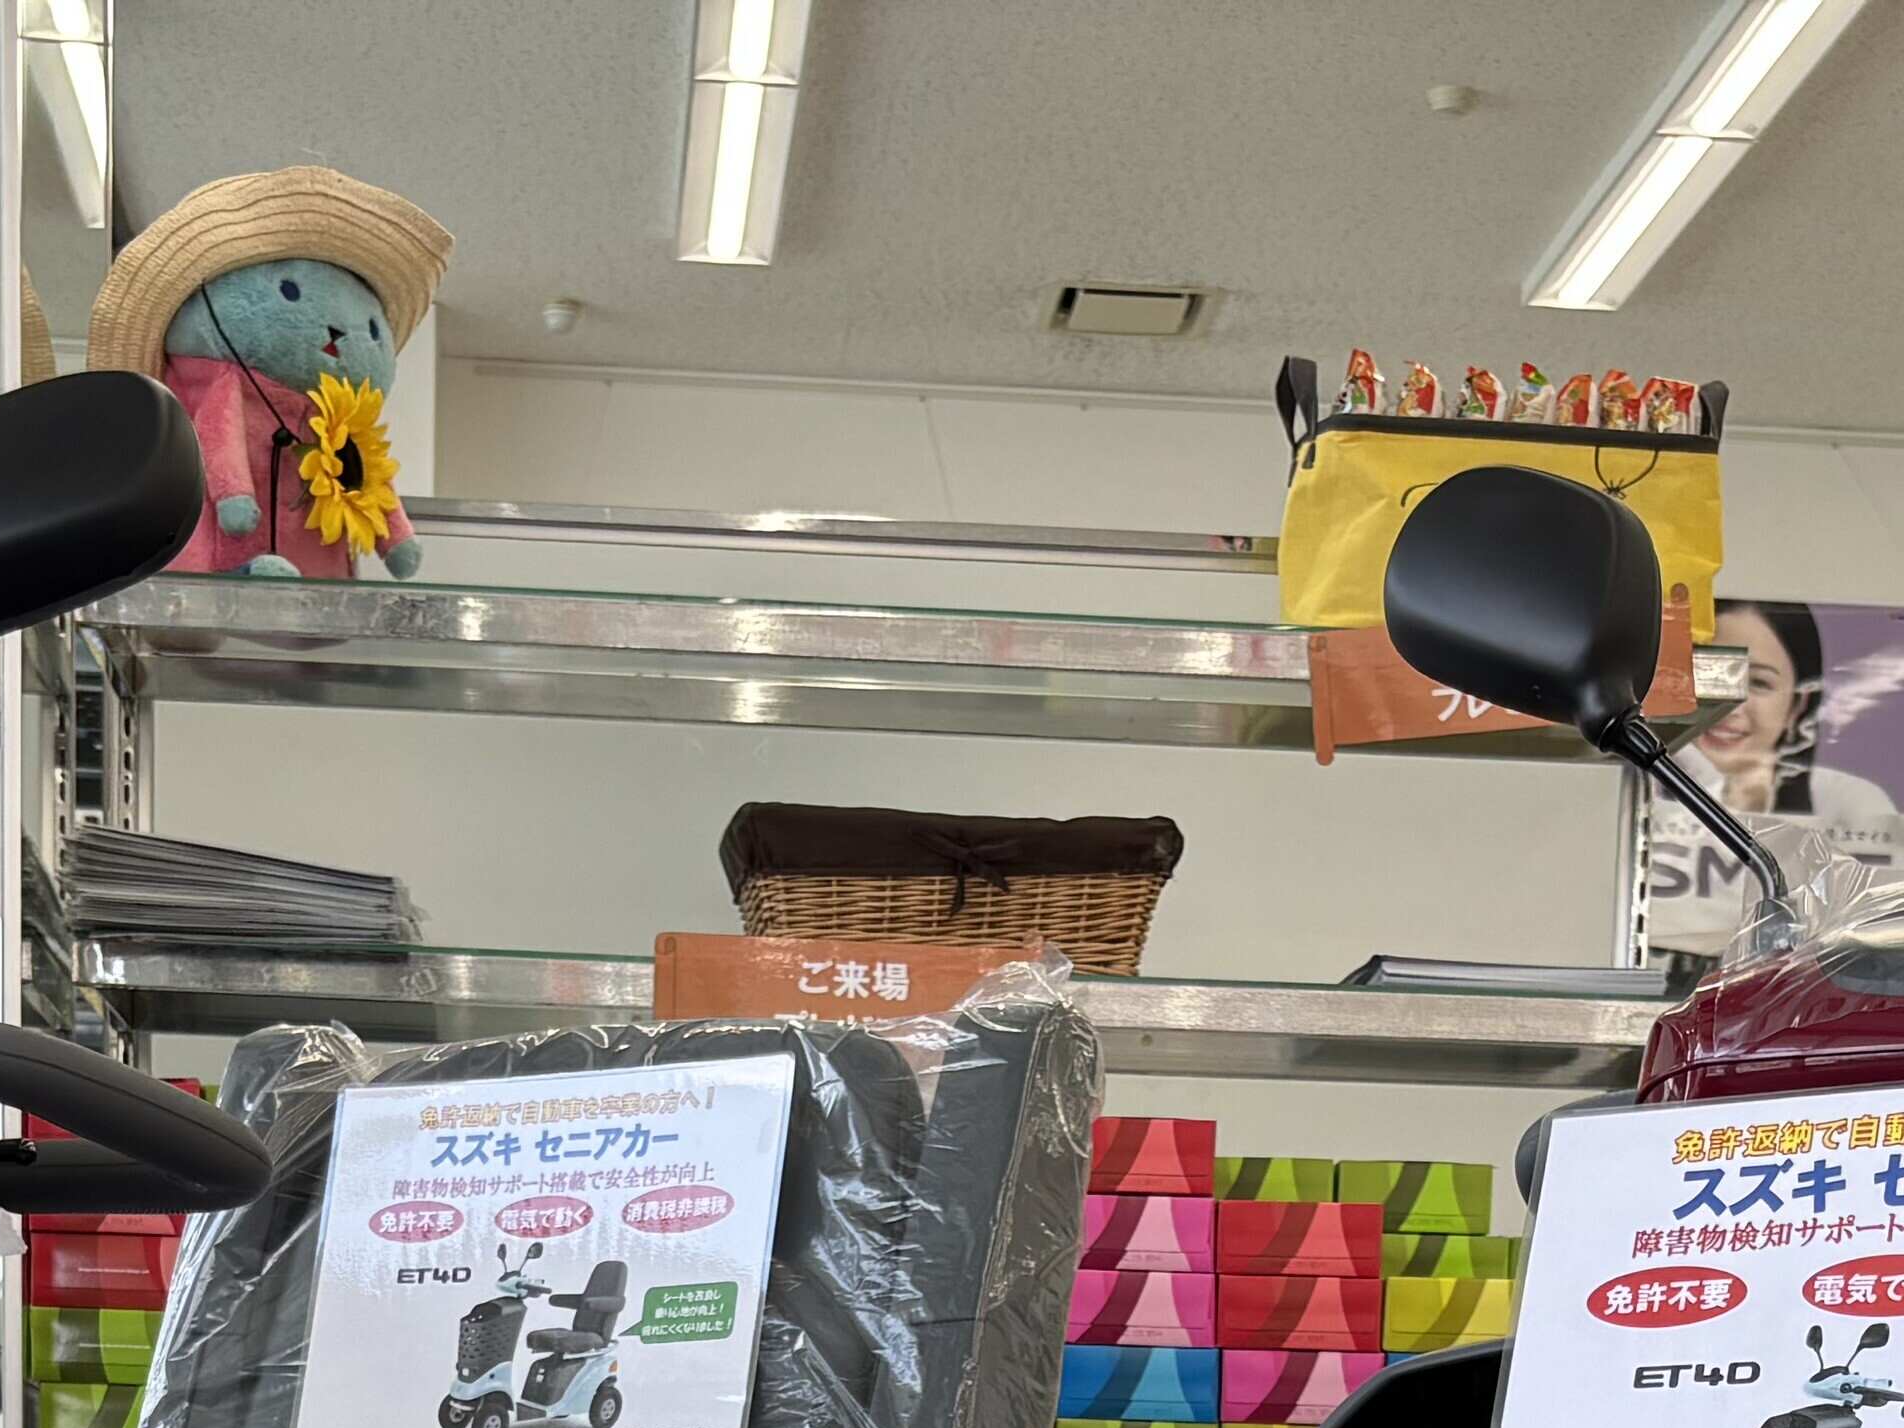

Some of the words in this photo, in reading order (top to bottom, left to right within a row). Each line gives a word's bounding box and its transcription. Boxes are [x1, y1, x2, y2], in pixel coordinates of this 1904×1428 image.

[796, 959, 911, 1003] ご来場
[431, 1130, 522, 1168] スズキ
[534, 1122, 679, 1163] セニアカー
[392, 1161, 715, 1200] 障害物検知サポート搭載で安全性が向上
[1672, 1157, 1846, 1220] スズキ
[380, 1211, 456, 1234] 免許不要
[397, 1266, 472, 1285] ET4D
[1605, 1278, 1733, 1315] 免許不要
[1633, 1361, 1761, 1388] ET4D
